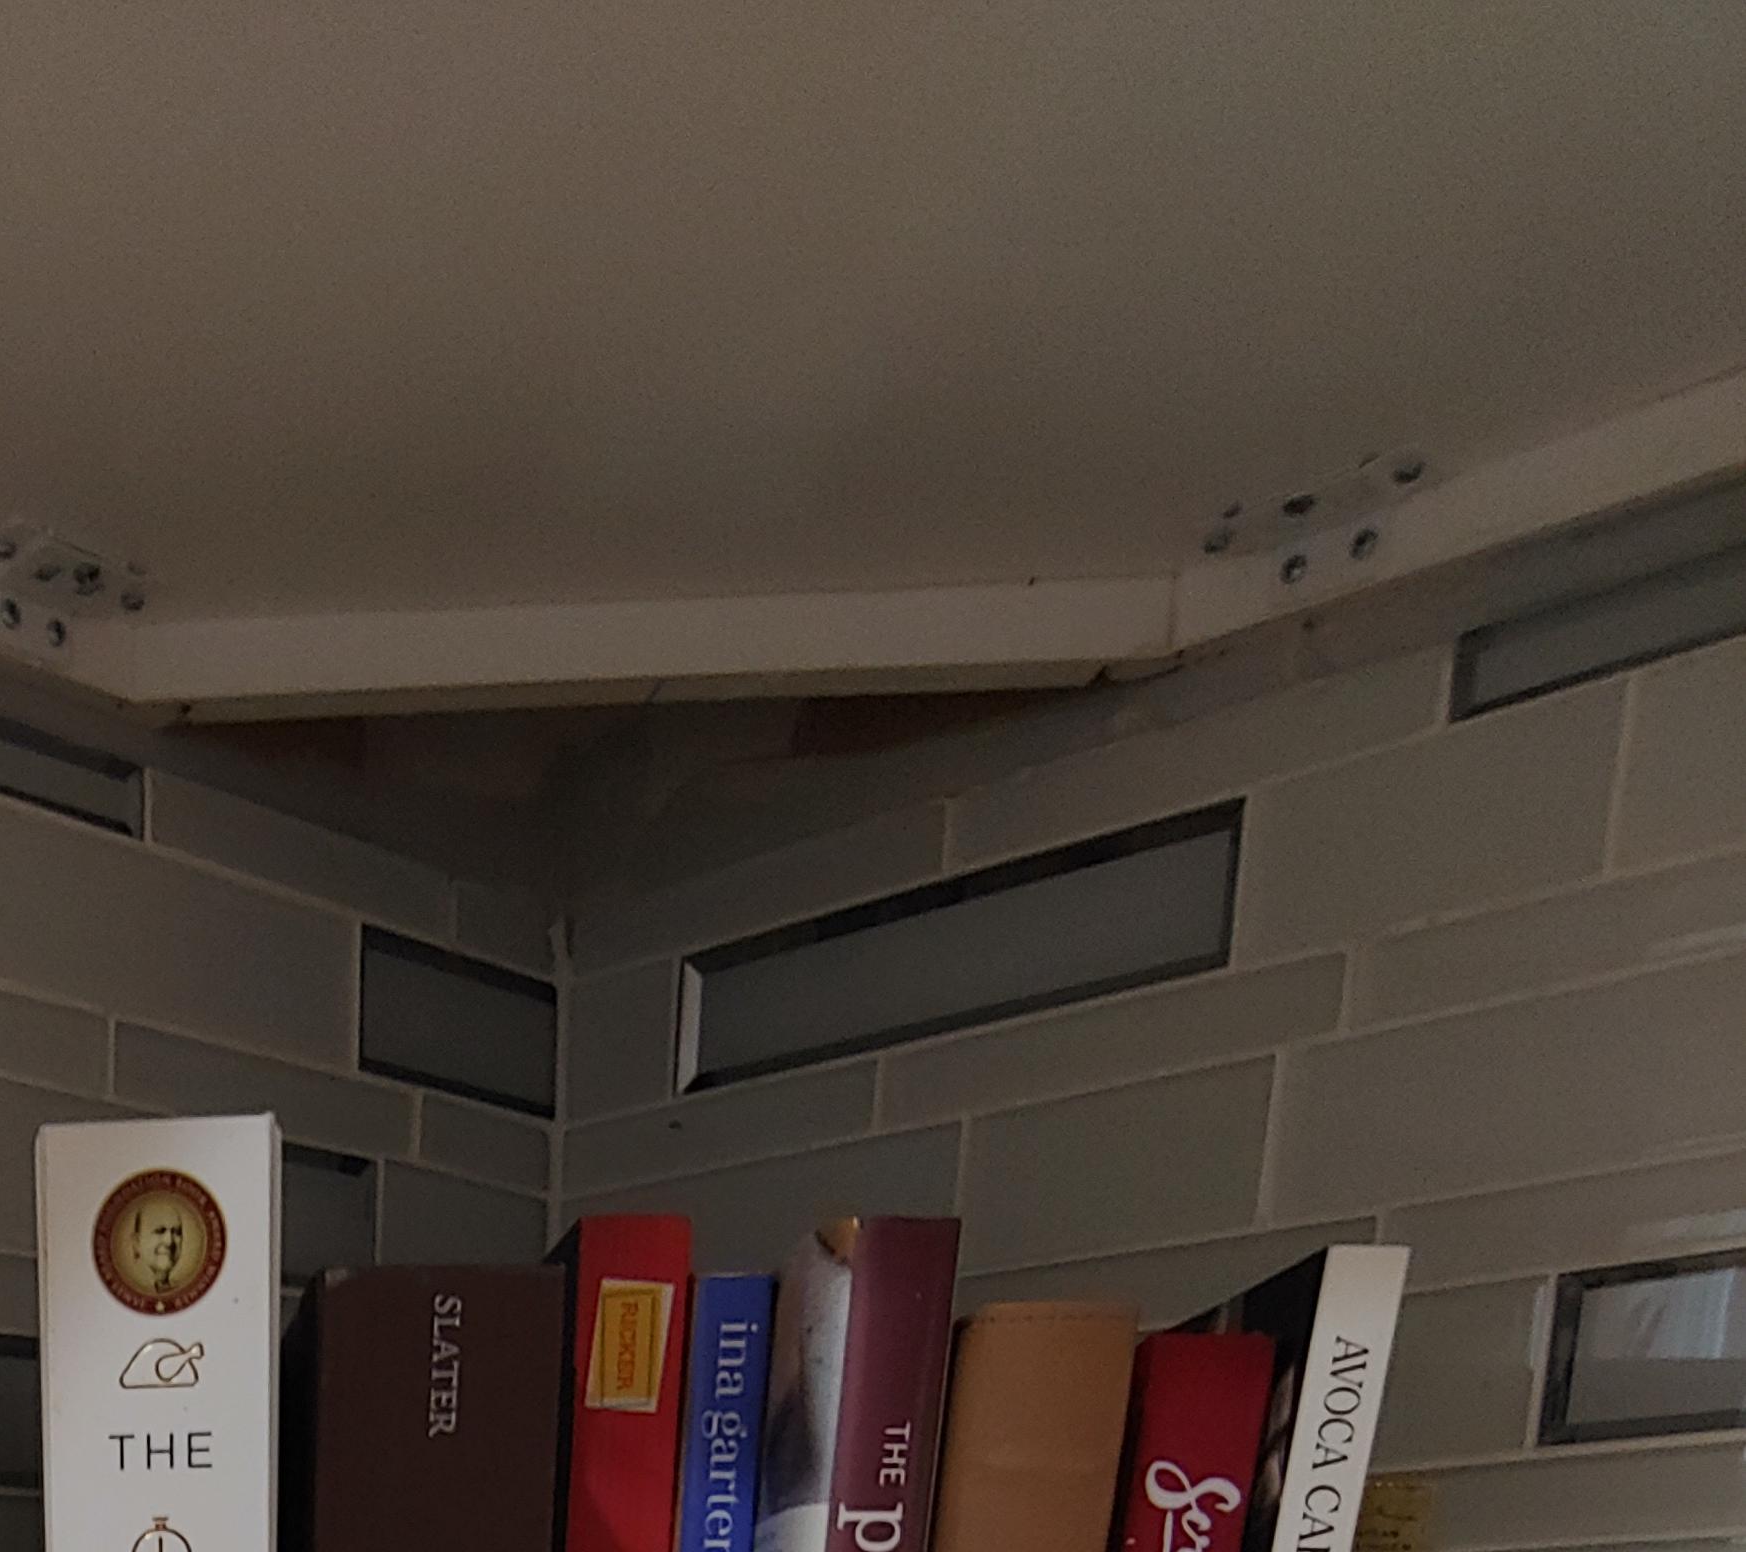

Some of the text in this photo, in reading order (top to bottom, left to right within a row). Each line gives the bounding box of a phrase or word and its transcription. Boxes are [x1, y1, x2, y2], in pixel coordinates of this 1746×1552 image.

[427, 1294, 462, 1440] SLATER
[616, 1299, 639, 1392] RICKER
[715, 1320, 758, 1399] ina
[1312, 1335, 1370, 1471] AVOCA
[108, 1431, 214, 1471] THE
[878, 1420, 911, 1487] THE
